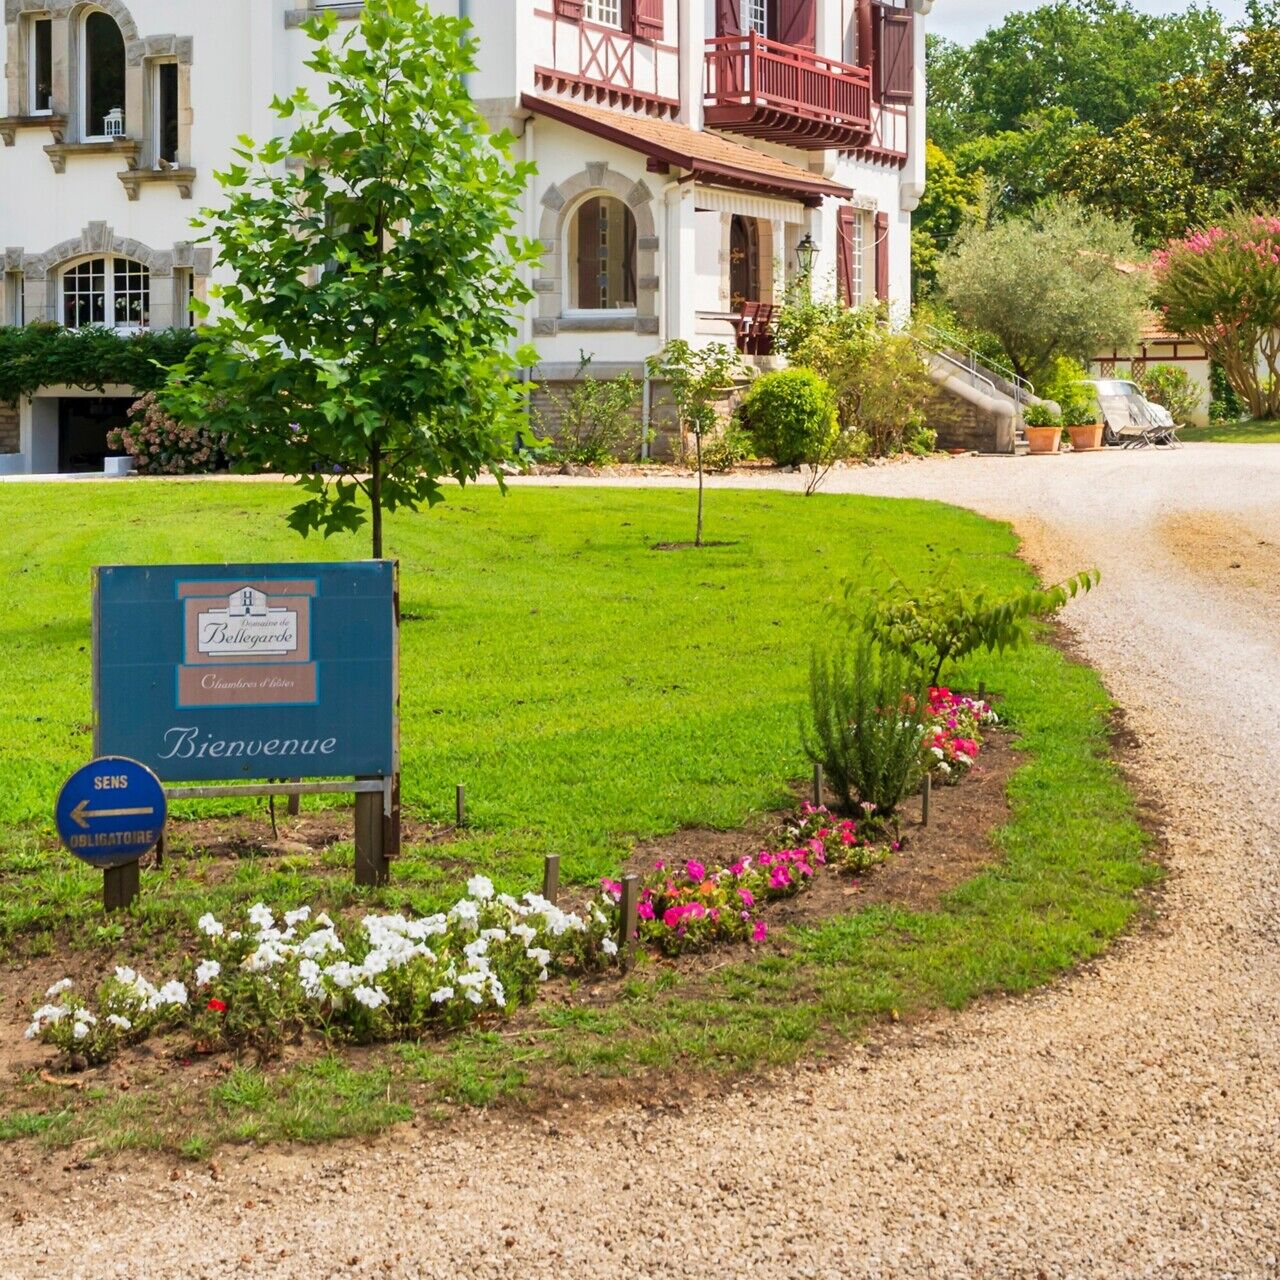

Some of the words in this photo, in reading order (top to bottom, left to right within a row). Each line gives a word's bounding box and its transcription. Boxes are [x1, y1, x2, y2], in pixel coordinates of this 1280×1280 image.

[241, 619, 278, 627] Domaine
[279, 618, 289, 626] de
[201, 622, 292, 649] Bellegarde
[201, 673, 258, 690] Chambres
[157, 726, 336, 759] Bienvenue
[94, 775, 128, 790] SENS
[70, 830, 153, 847] OBLIGATOIRE
